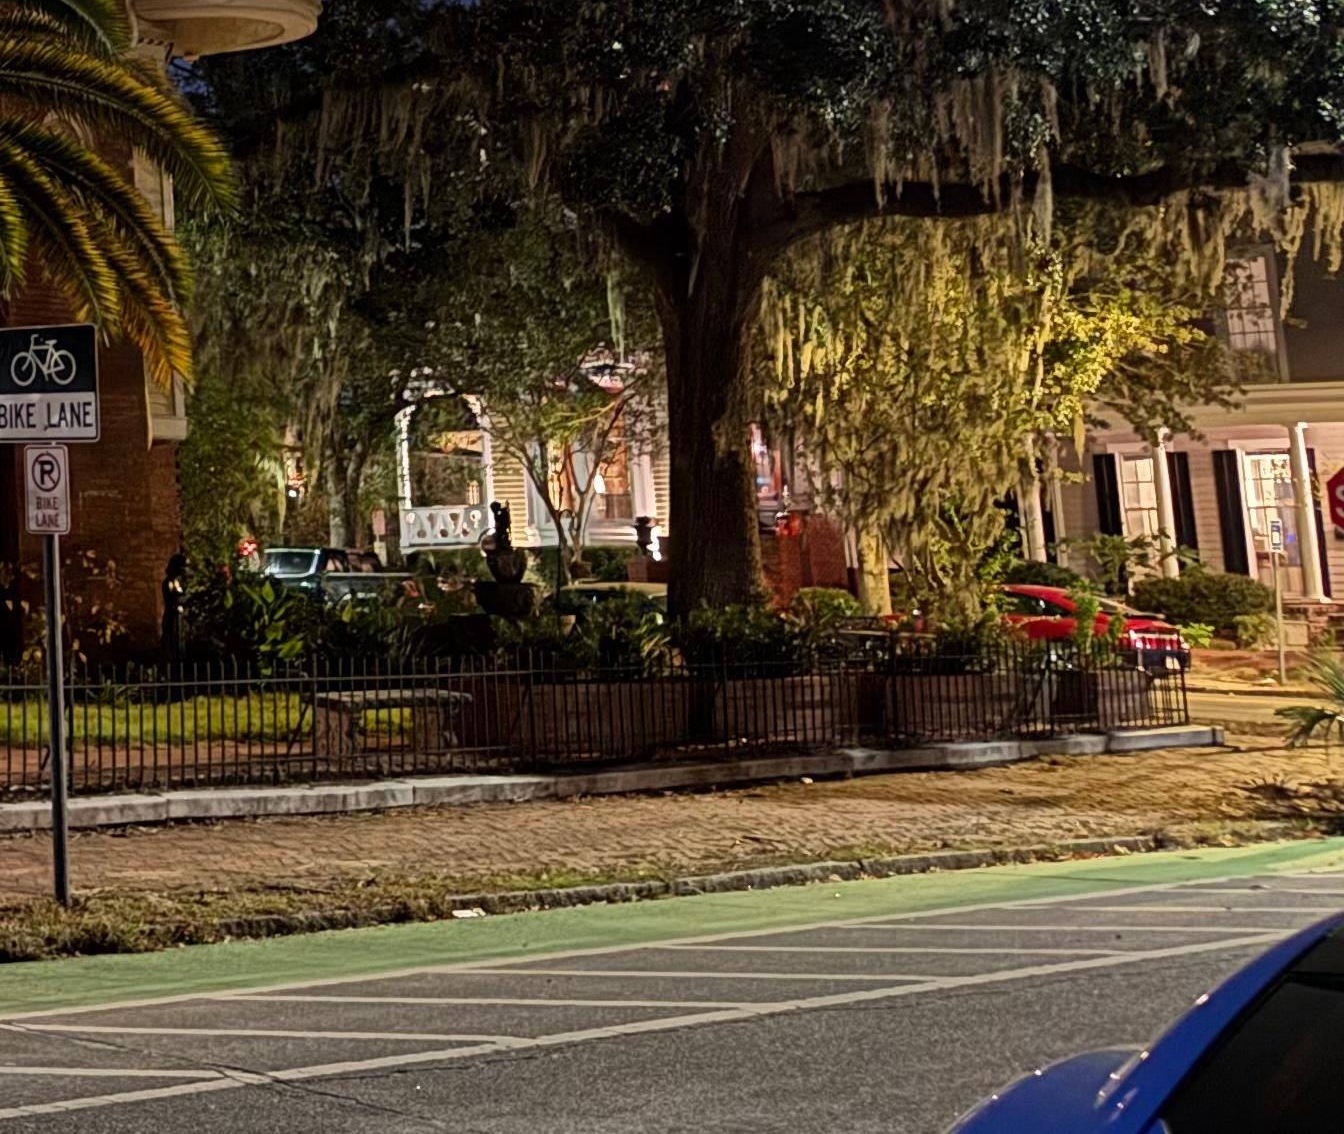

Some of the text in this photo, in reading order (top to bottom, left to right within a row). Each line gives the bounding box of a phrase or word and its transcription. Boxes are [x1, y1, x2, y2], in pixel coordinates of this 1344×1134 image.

[46, 401, 93, 428] LANE
[36, 496, 60, 510] BIKE
[36, 512, 60, 528] LANE
